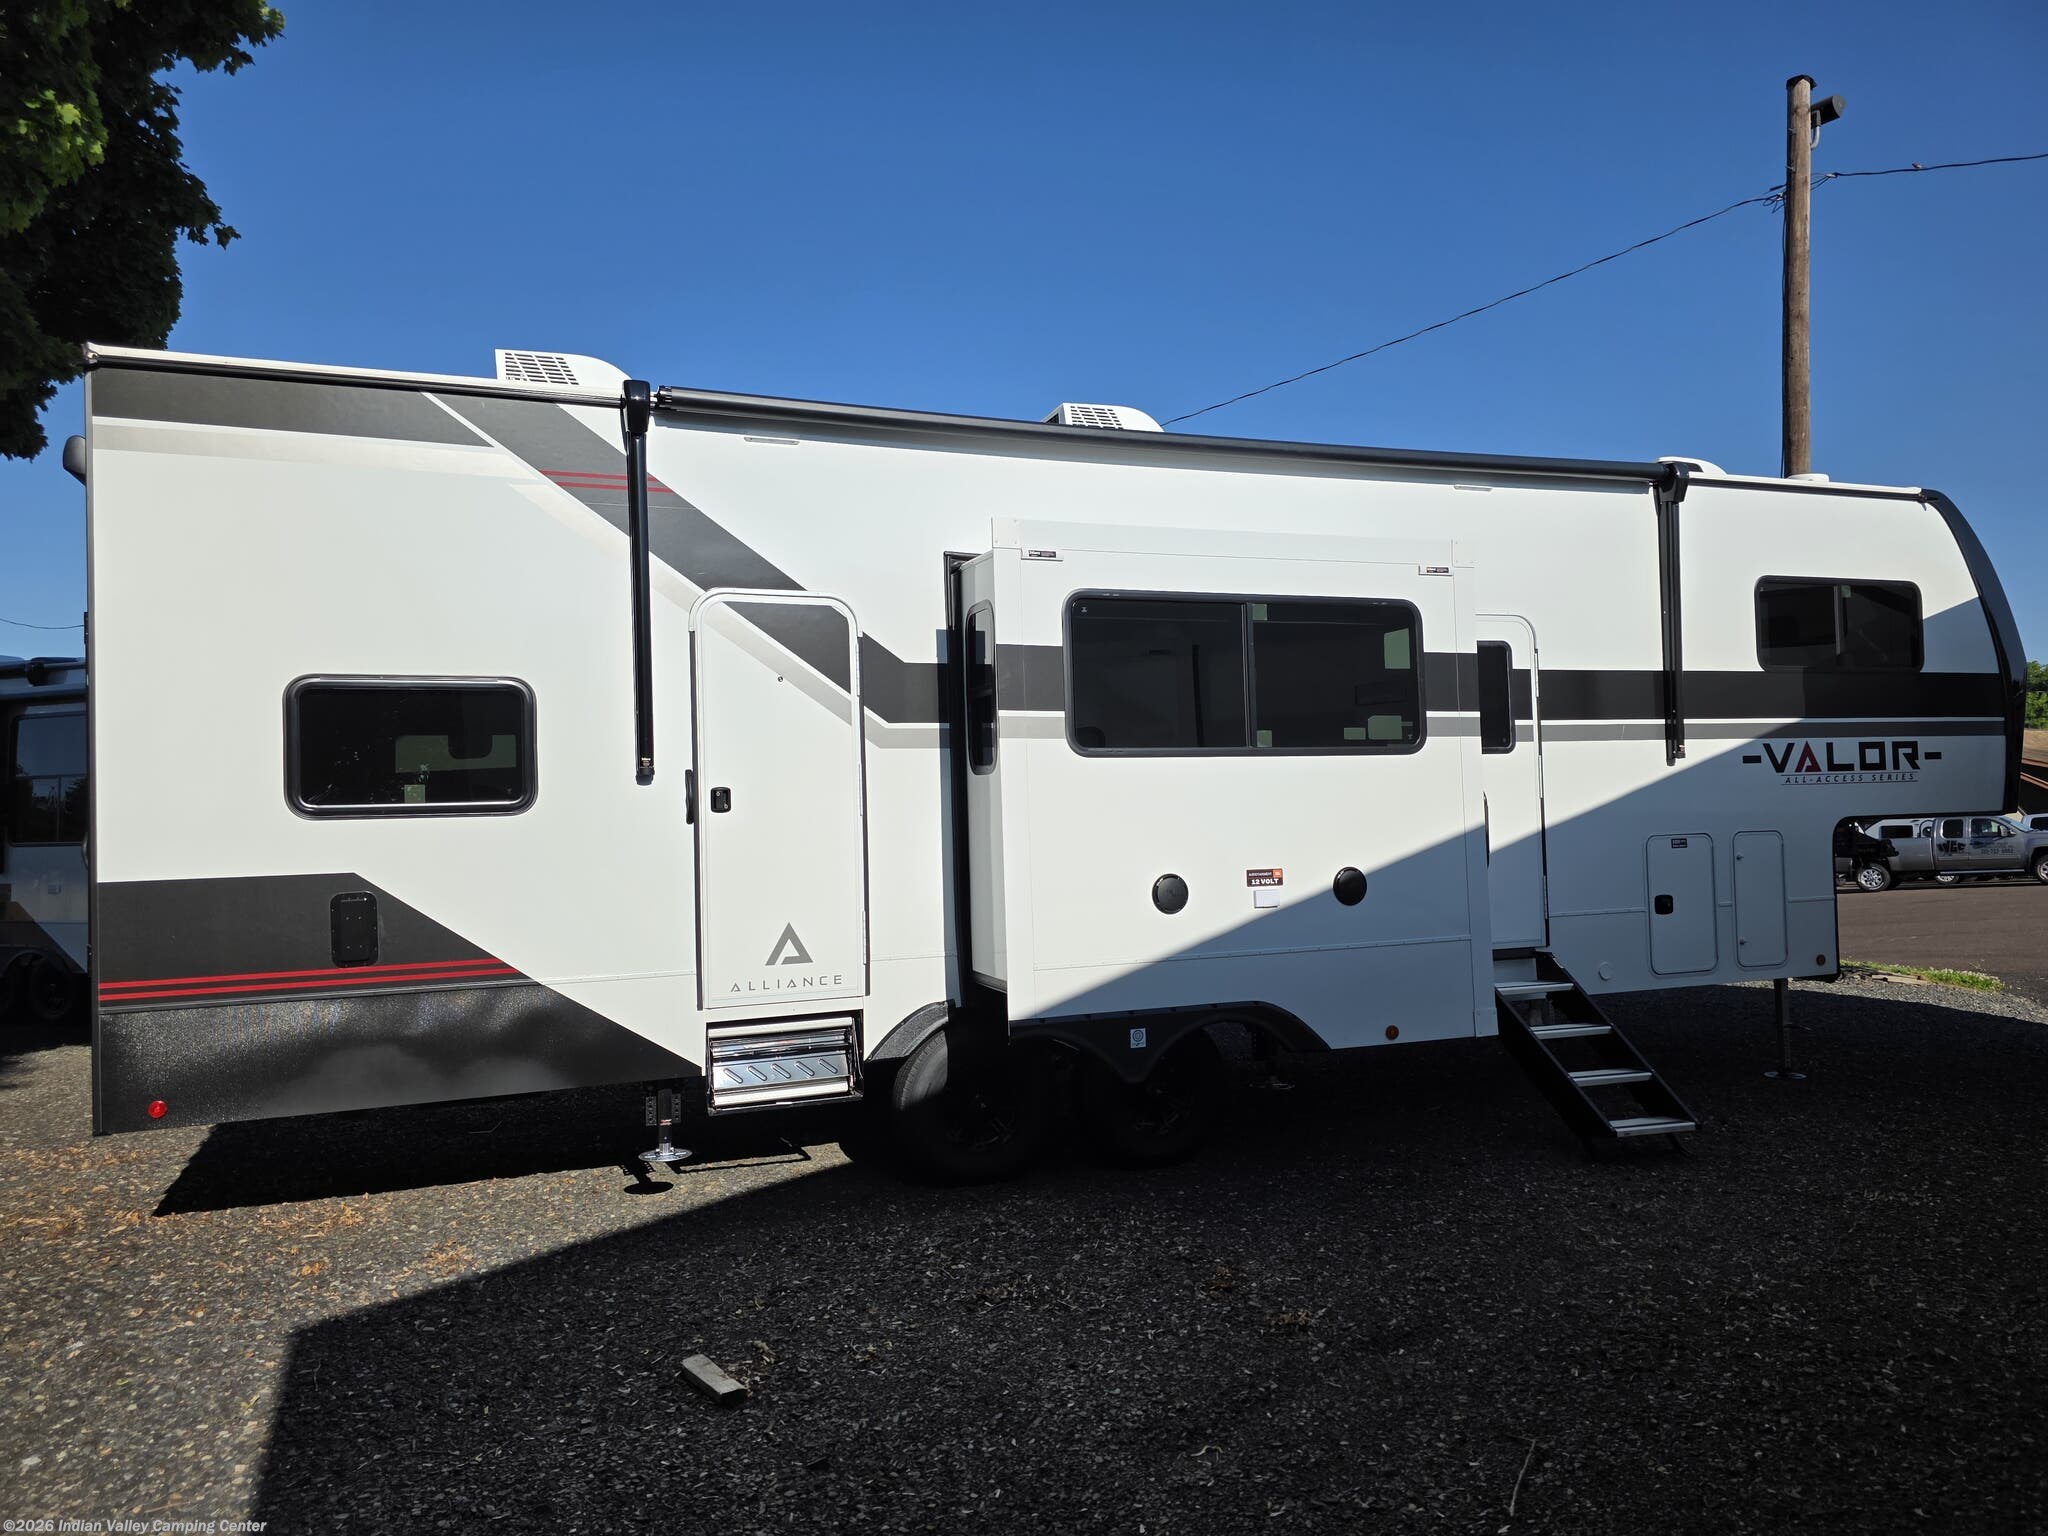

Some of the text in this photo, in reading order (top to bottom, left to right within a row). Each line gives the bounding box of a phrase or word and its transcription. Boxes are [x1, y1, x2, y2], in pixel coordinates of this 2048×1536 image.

[1784, 772, 1915, 784] ALL-ACCESS SERIES
[730, 974, 842, 993] ALLIANCE
